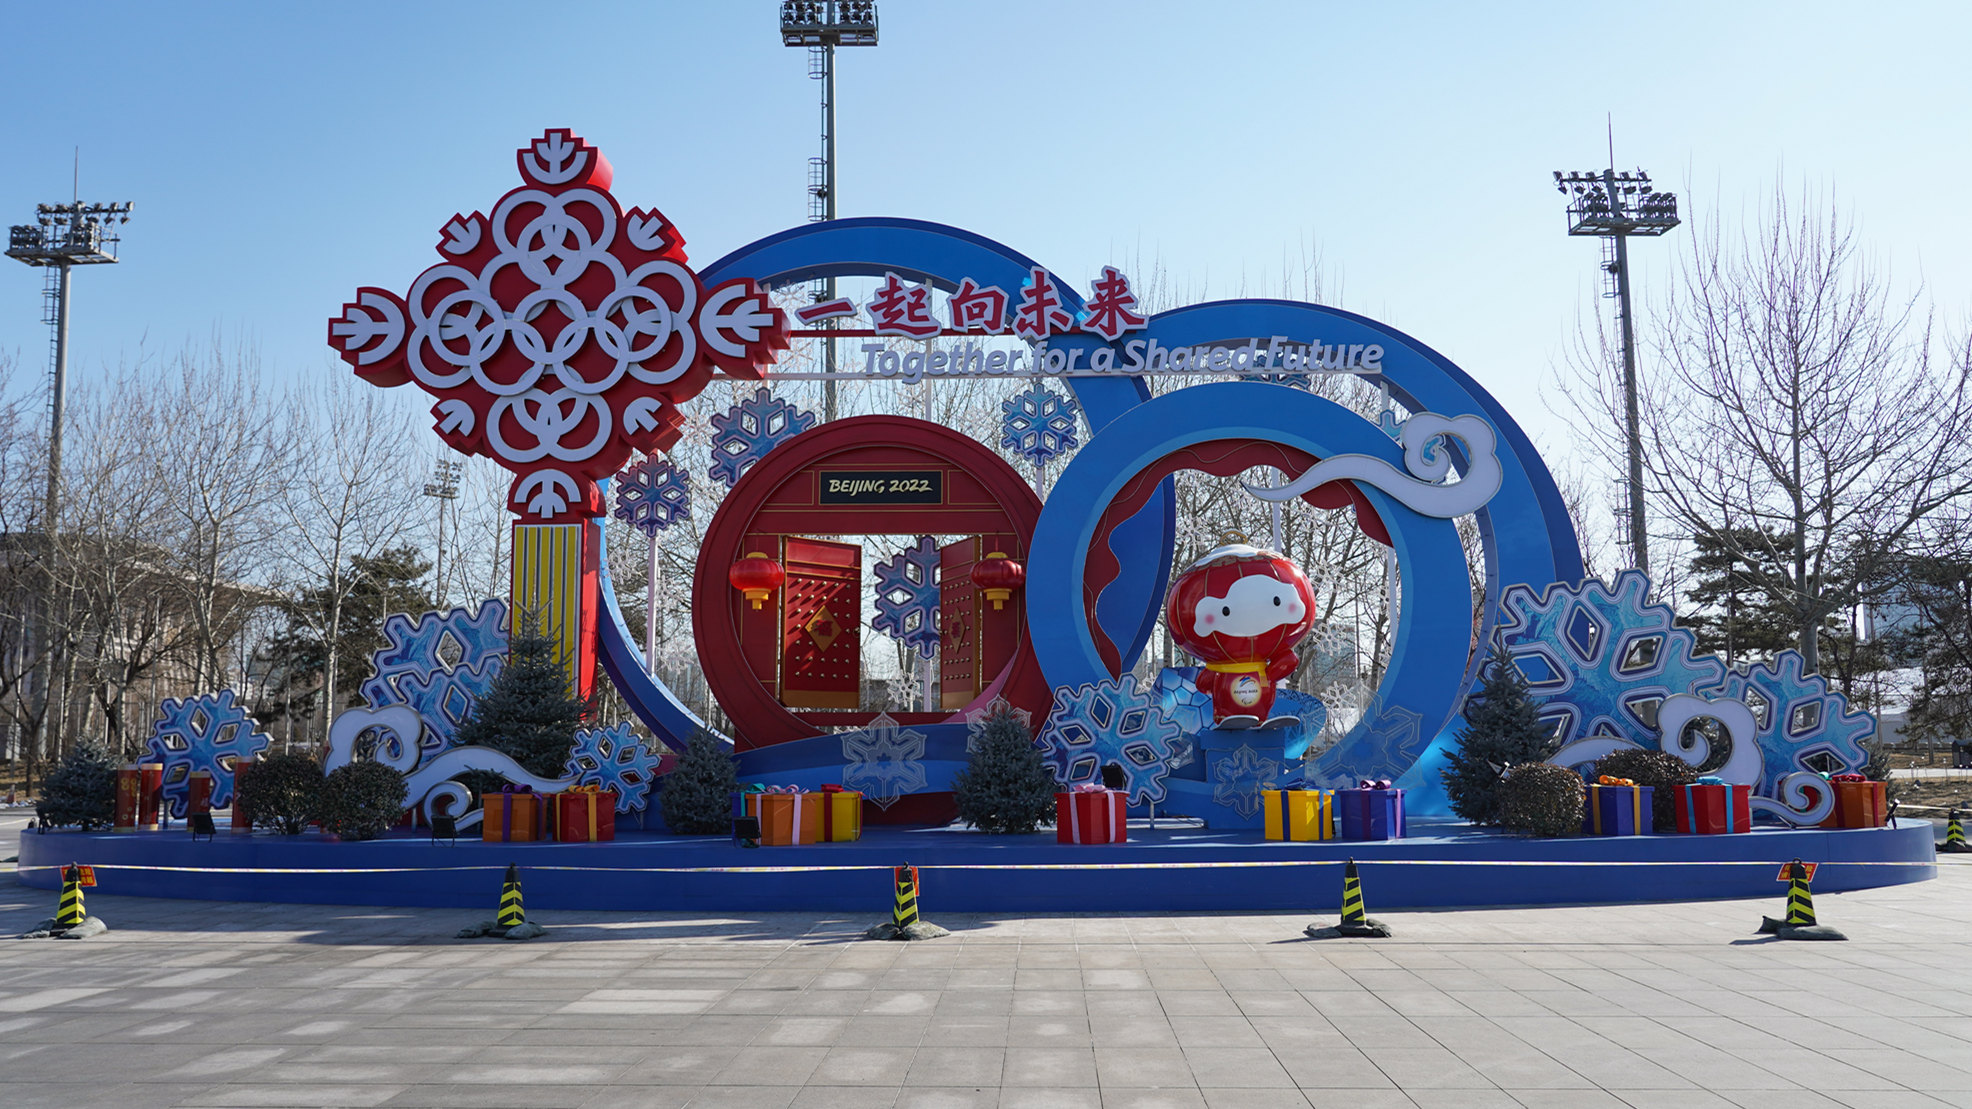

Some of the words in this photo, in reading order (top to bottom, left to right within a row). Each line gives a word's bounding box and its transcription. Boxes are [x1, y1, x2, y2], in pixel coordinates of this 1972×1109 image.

[795, 266, 1150, 341] 一起向未来
[861, 342, 1023, 384] Together
[1031, 341, 1085, 375] for
[1090, 347, 1116, 374] a
[1121, 337, 1259, 373] Shared
[1264, 335, 1385, 371] Future
[829, 479, 885, 497] BEIJING
[888, 479, 934, 492] 2022
